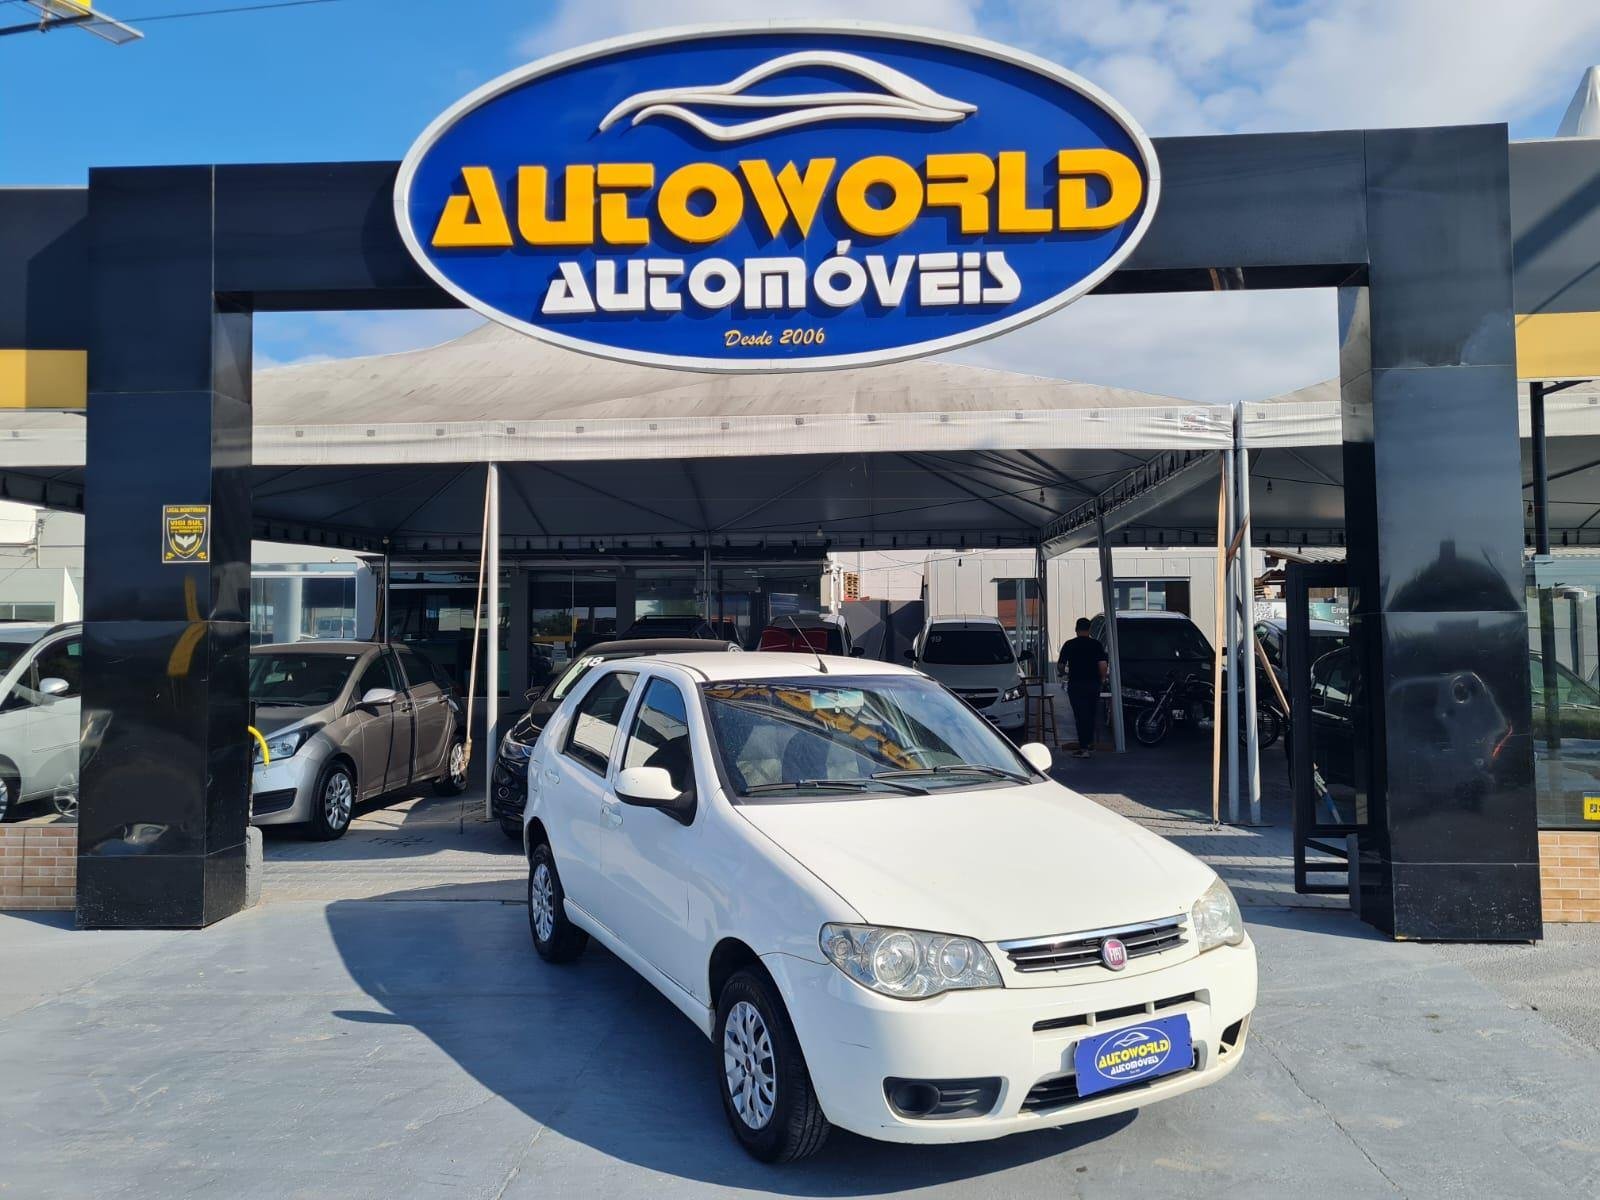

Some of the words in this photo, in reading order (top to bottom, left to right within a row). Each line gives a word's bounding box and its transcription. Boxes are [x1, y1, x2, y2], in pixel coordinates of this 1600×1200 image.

[431, 148, 1143, 247] AUTOWORLD
[541, 240, 1022, 314] AUTOMÓVEIS
[724, 330, 773, 347] Desde
[779, 328, 825, 345] 2006
[1098, 1039, 1169, 1069] AUTOWORLD
[1110, 1055, 1159, 1075] AUTOMÓVEIS
